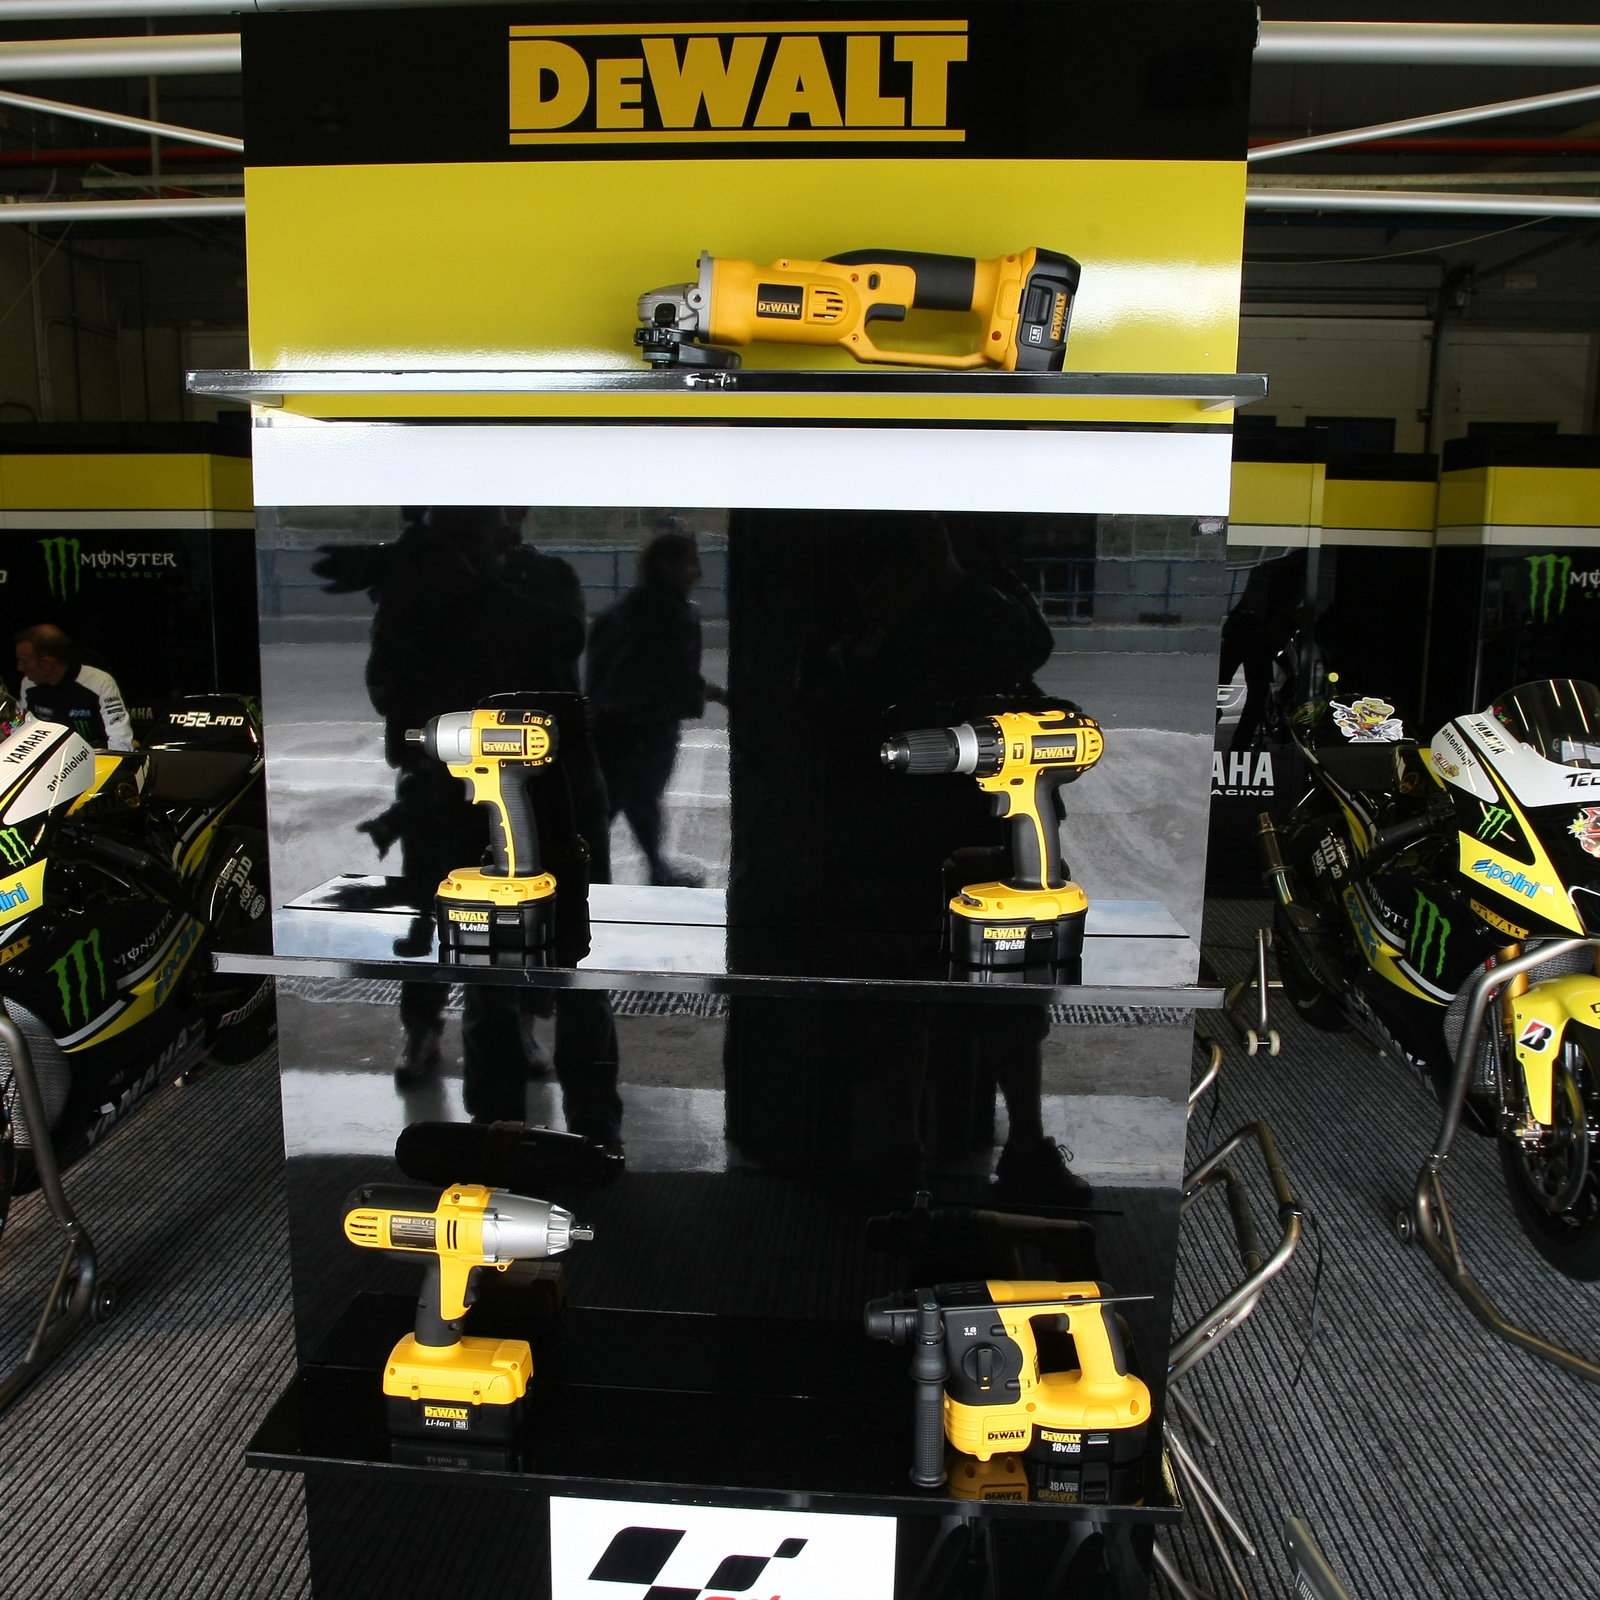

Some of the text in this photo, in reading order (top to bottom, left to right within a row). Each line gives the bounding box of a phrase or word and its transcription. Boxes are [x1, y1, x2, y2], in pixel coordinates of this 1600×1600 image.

[509, 36, 968, 130] DEWALT
[758, 302, 800, 314] DEWALT
[1050, 293, 1067, 340] DEWALT
[80, 549, 177, 568] MONSTER
[3, 729, 51, 764] YAMAHA
[483, 742, 521, 752] DEWALT
[1034, 746, 1075, 759] DEWALT
[1442, 728, 1475, 767] antoniolupi
[47, 746, 90, 791] antoniolupi
[1486, 863, 1541, 898] polini
[449, 910, 489, 923] DEWALT
[984, 928, 1026, 938] DEWALT
[425, 1406, 467, 1418] DEWALT
[425, 1418, 451, 1428] Li-Ion
[988, 1430, 1025, 1440] DEWALT
[1040, 1430, 1081, 1443] DEWALT
